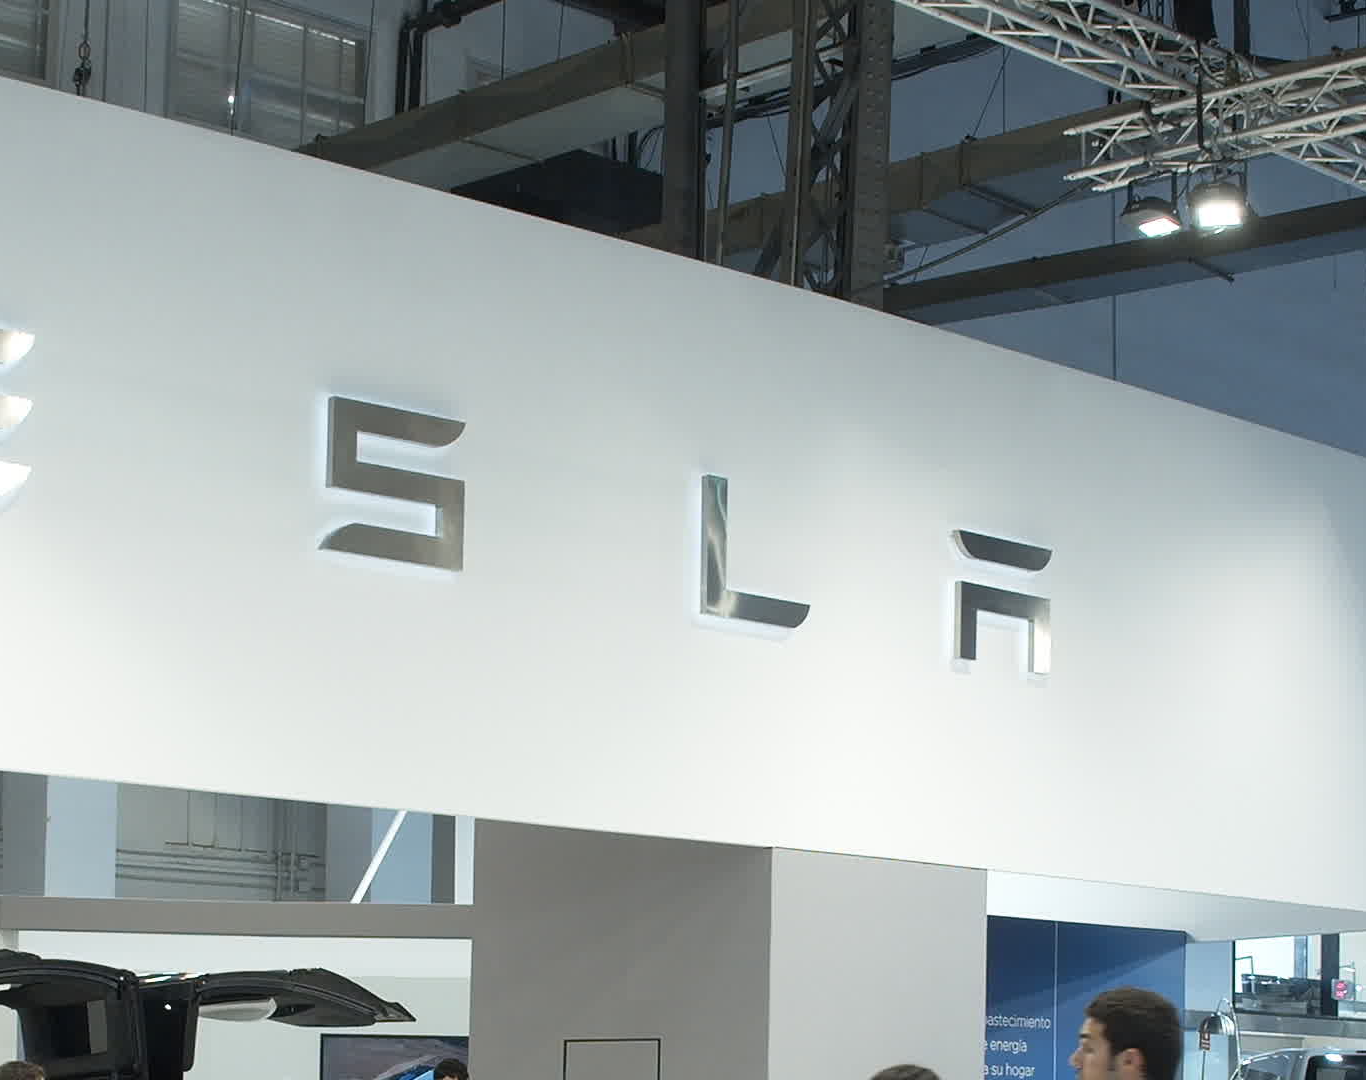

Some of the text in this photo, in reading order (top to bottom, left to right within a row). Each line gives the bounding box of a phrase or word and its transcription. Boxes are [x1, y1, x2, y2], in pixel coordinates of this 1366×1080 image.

[986, 1014, 1051, 1029] astecimiento
[990, 1040, 1027, 1054] energía
[990, 1064, 1004, 1076] su
[1005, 1062, 1035, 1079] hogar
